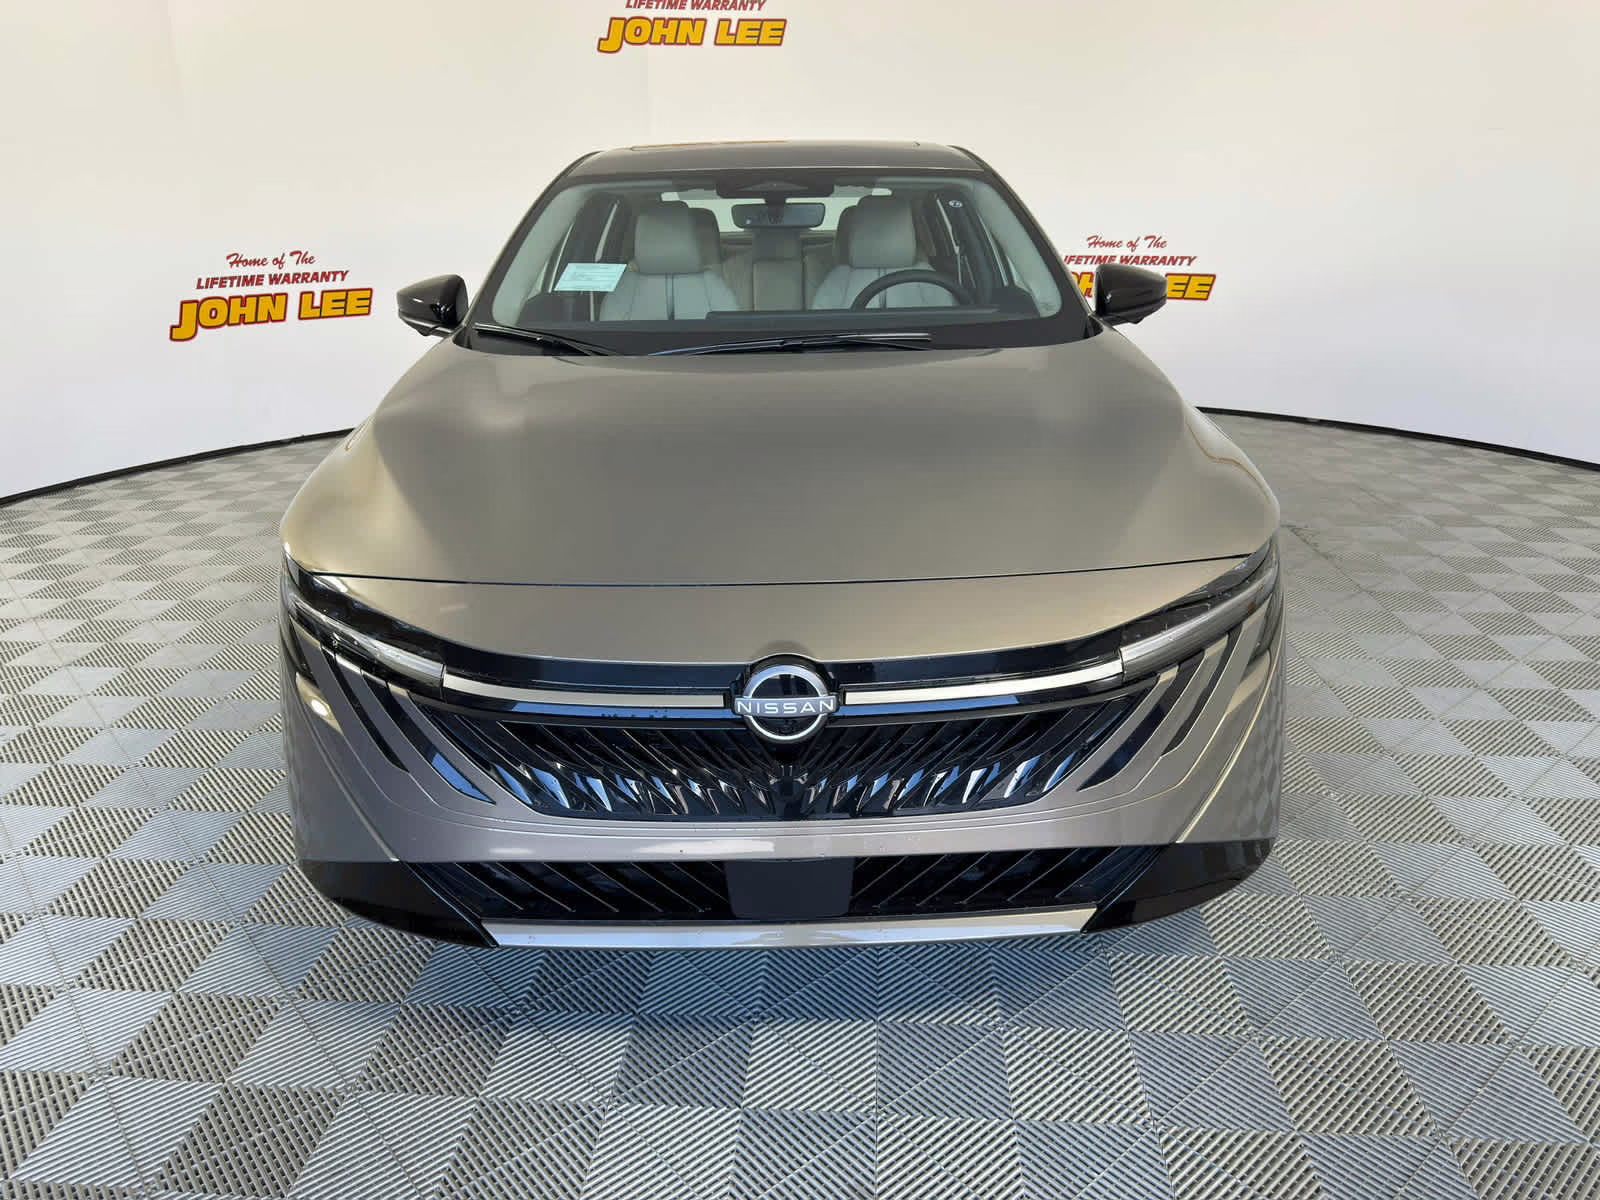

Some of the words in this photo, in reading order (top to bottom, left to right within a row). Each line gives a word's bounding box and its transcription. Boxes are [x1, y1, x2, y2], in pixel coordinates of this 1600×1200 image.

[625, 0, 687, 10] LIFETIME
[690, 0, 767, 11] WARRANTY
[598, 17, 707, 54] JOHN
[714, 18, 787, 46] LEE
[1086, 235, 1123, 249] Home
[1126, 237, 1140, 252] of
[1143, 235, 1168, 249] The
[226, 252, 269, 268] Home
[272, 253, 286, 270] of
[290, 250, 316, 266] The
[1063, 255, 1117, 265] IFETIME
[1119, 255, 1198, 267] WARRANTY
[195, 273, 265, 290] LIFETIME
[268, 270, 350, 286] WARRANTY
[1165, 273, 1217, 301] EE
[170, 292, 289, 342] JOHN
[298, 288, 373, 320] LEE
[737, 698, 834, 714] NISSAN
